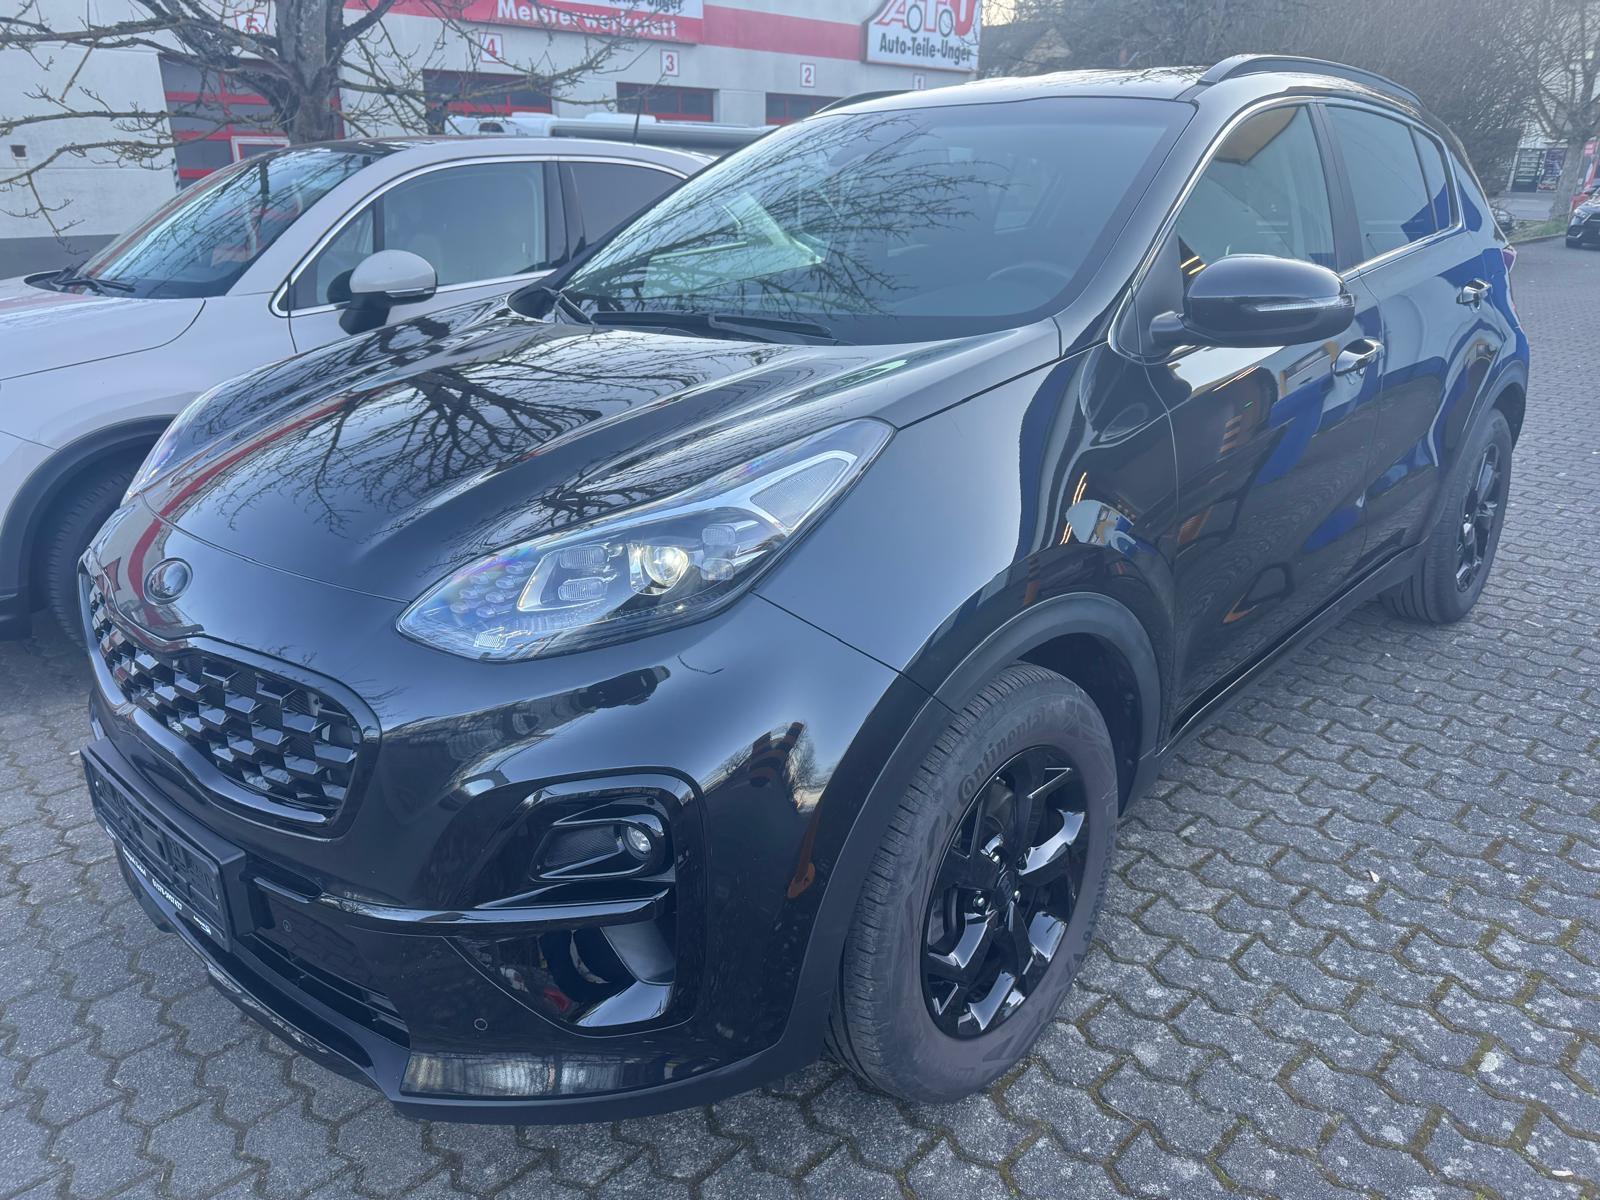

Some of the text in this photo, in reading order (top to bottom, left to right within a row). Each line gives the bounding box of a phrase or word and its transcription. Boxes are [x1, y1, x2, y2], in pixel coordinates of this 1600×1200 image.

[486, 38, 497, 57] 4
[879, 33, 971, 65] Auto-Teile-Unger
[666, 54, 675, 71] 3
[804, 67, 811, 84] 2
[958, 702, 1047, 806] Continental
